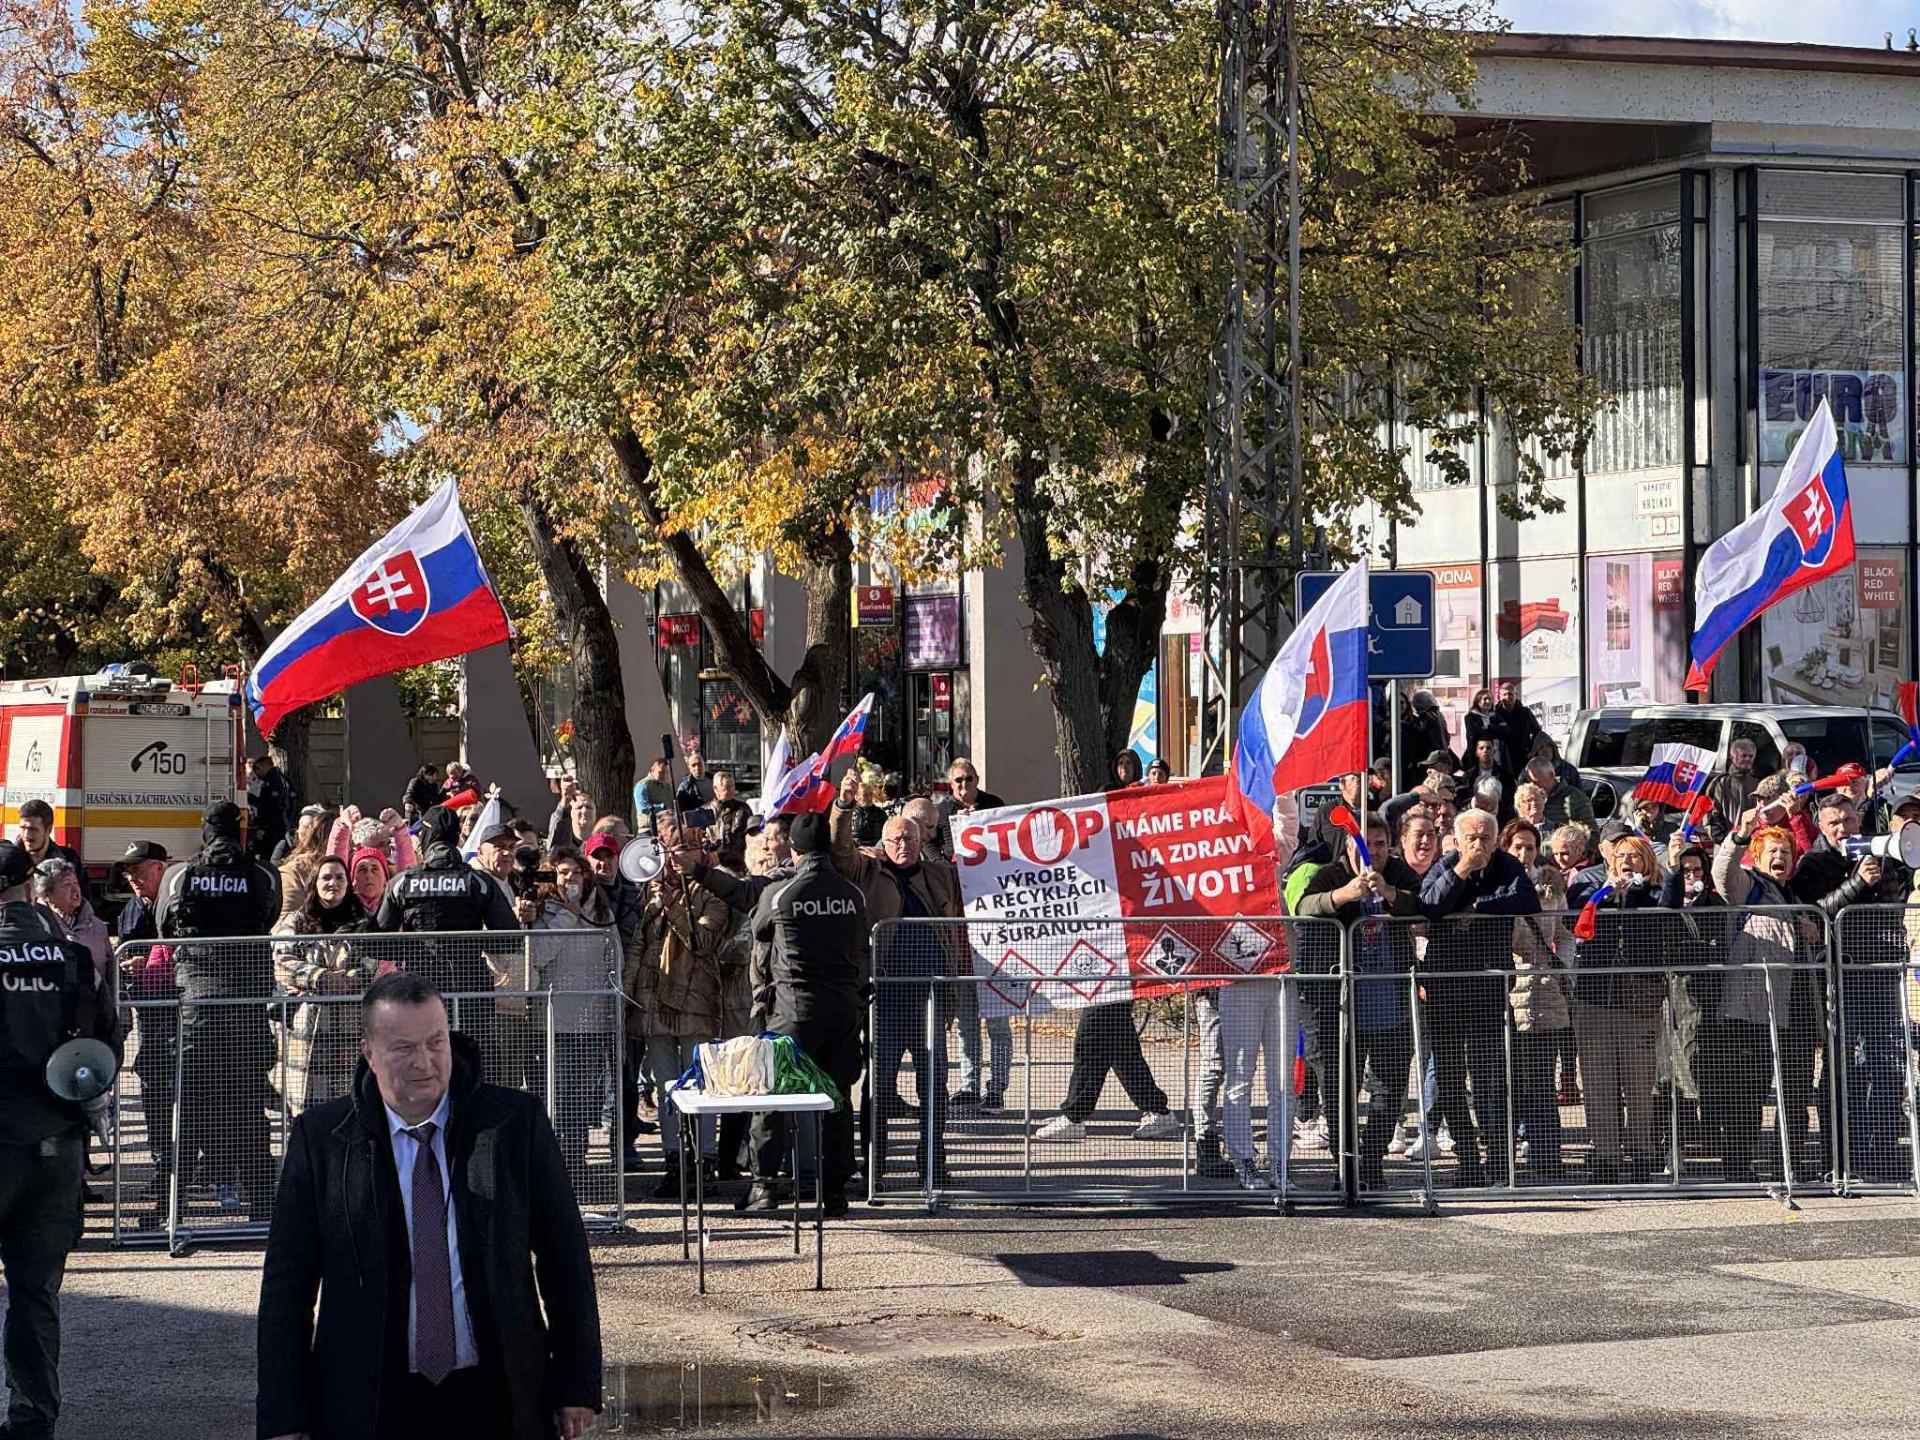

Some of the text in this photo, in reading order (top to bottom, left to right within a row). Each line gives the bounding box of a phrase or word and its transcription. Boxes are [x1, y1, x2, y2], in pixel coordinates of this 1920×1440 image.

[1765, 373, 1898, 424] EURO
[1657, 568, 1680, 580] BLACK
[1864, 567, 1895, 577] BLACK
[1657, 581, 1672, 592] RED
[1864, 579, 1884, 589] RED
[1657, 592, 1680, 603] WHITE
[1864, 591, 1895, 601] WHITE
[149, 752, 186, 775] 150
[86, 790, 132, 805] HASIČSKÁ
[135, 790, 191, 805] ZÁCHRANNÁ
[1116, 811, 1184, 840] MÁME
[960, 806, 1104, 867] STOP
[1131, 848, 1164, 869] NA
[190, 874, 248, 894] POLÍCIA
[409, 872, 466, 893] POLÍCIA
[998, 865, 1077, 891] VÝROBE
[1141, 864, 1255, 908] ŽIVOT!
[975, 878, 1107, 912] A RECYKLÁCII
[791, 896, 857, 918] POLÍCIA
[981, 931, 992, 947] V
[0, 942, 65, 963] OLÍCIA
